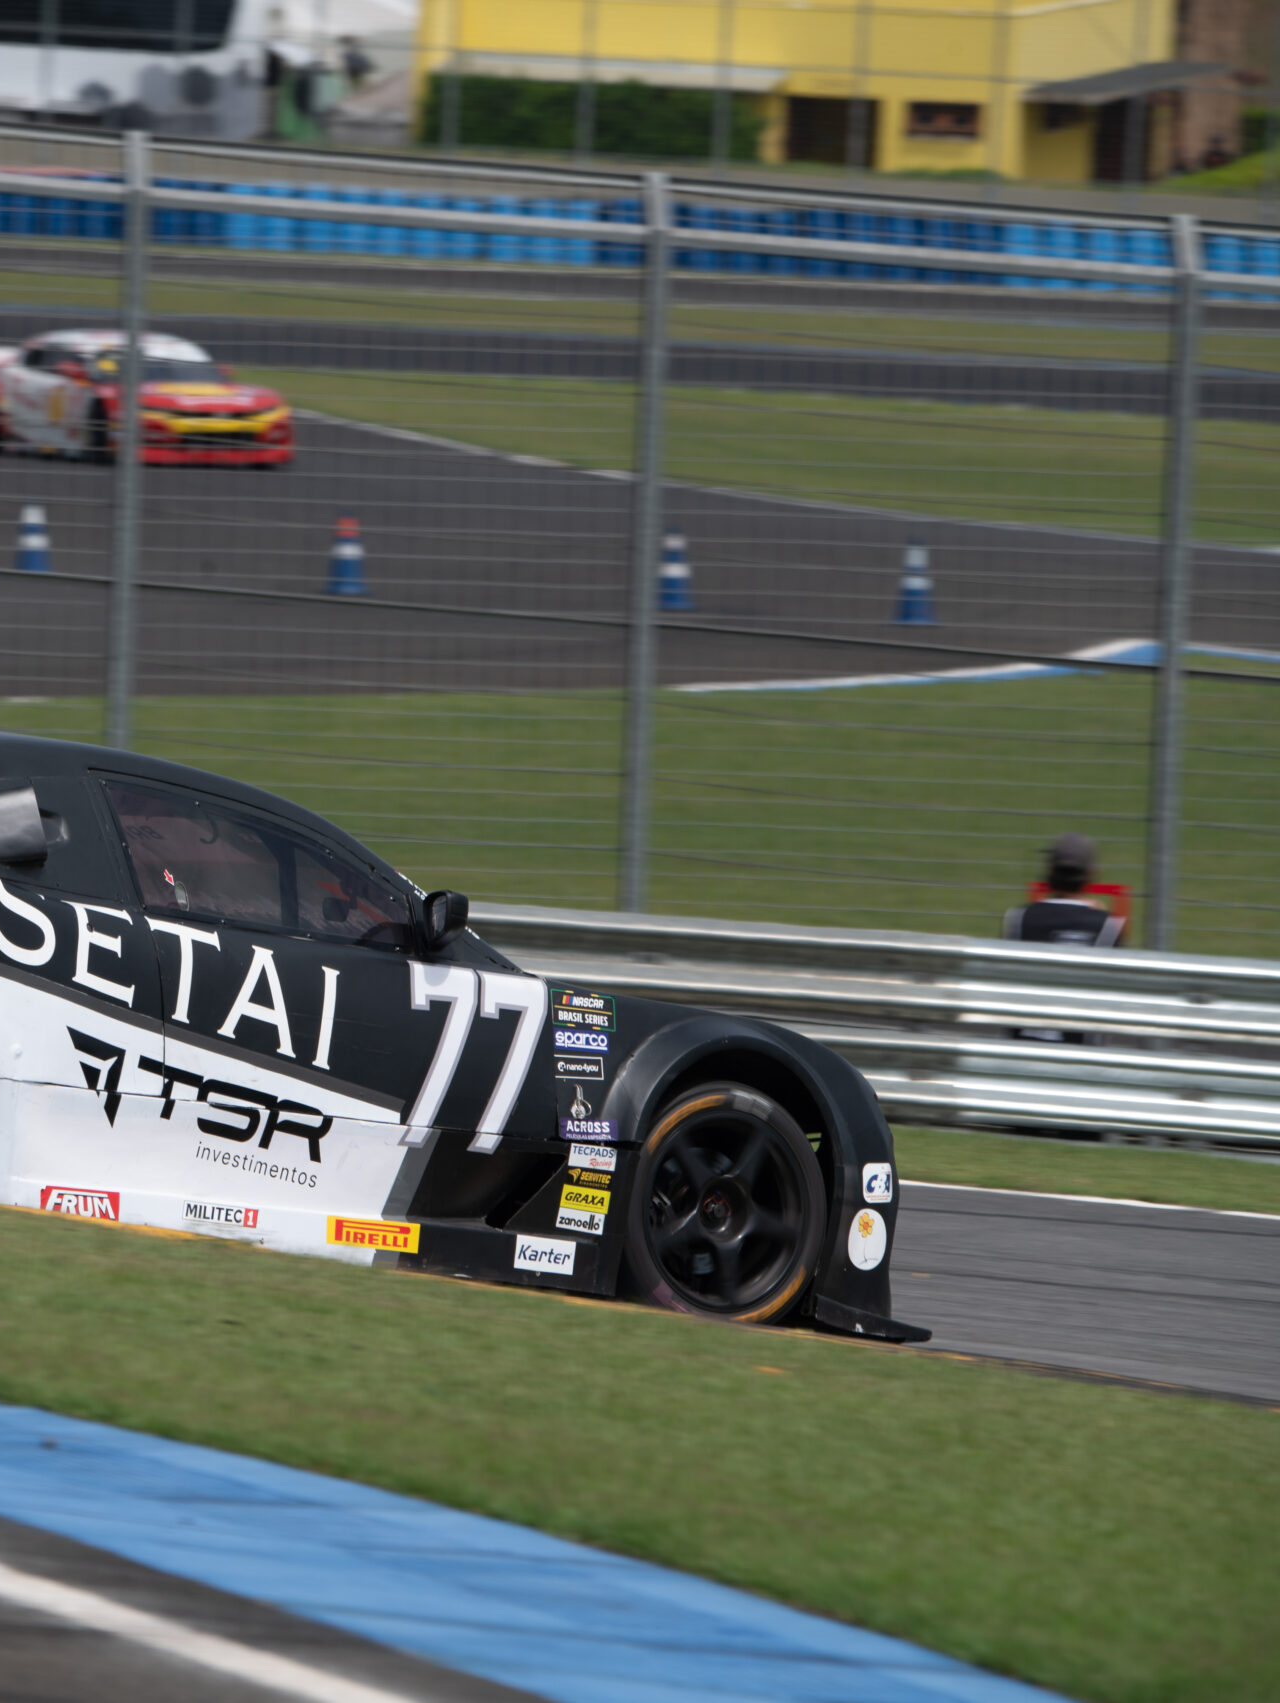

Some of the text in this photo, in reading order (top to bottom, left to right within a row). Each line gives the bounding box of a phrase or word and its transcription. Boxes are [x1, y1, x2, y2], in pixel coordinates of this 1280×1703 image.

[572, 995, 604, 1009] NASCAR
[558, 1010, 609, 1026] BRASIL SERIES
[555, 1031, 608, 1047] sparco
[397, 960, 549, 1156] 77
[138, 1055, 333, 1163] TSR
[566, 1120, 610, 1133] ACROSS
[573, 1145, 615, 1158] TECPADS
[196, 1142, 318, 1188] investimentos
[45, 1189, 116, 1220] FRUM
[565, 1191, 605, 1206] GRAXA
[185, 1203, 243, 1224] MILITEC
[559, 1214, 600, 1230] zanoello
[335, 1219, 411, 1249] PIRELLI
[517, 1244, 571, 1265] Karter
